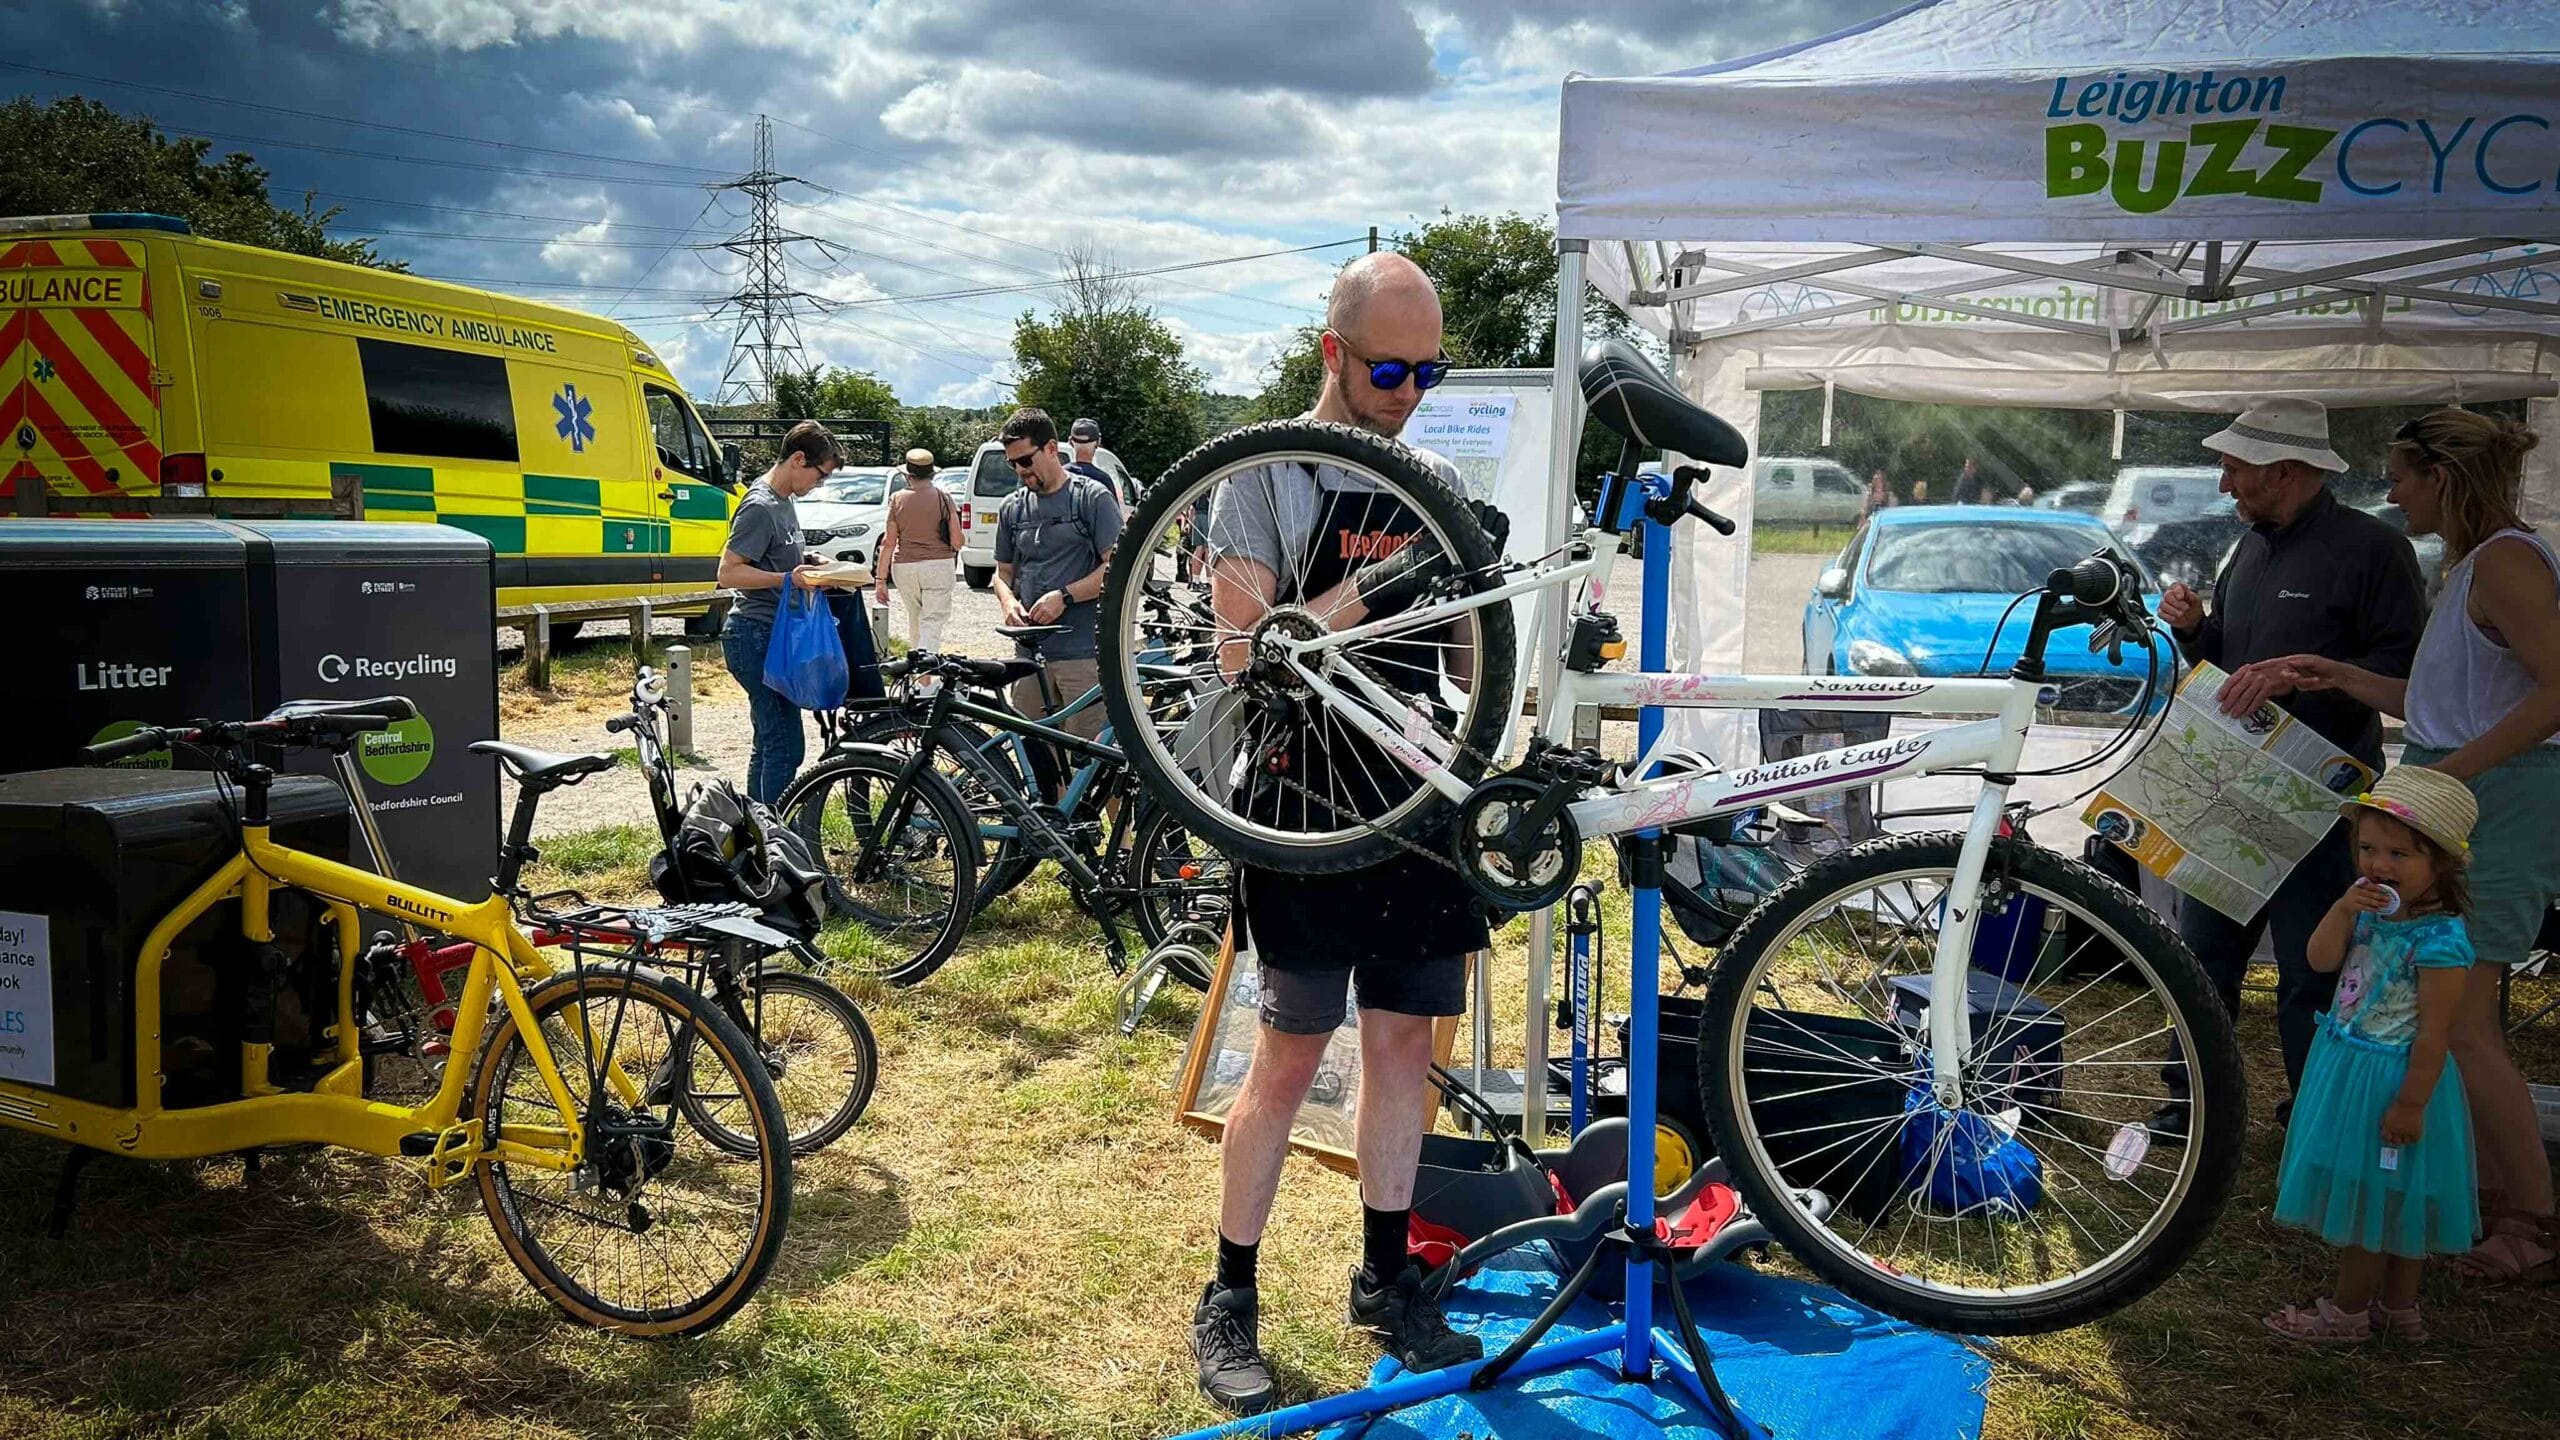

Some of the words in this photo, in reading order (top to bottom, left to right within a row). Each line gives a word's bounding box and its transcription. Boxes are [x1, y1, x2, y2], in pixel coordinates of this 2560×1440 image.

[2046, 71, 2287, 124] Leighton
[198, 306, 222, 318] 1006
[317, 296, 444, 336] EMERGENCY
[452, 319, 557, 353] AMBULANCE
[1468, 404, 1506, 417] cycling
[1424, 424, 1446, 434] Local
[1447, 424, 1465, 434] Bike
[1466, 424, 1491, 434] Rides
[356, 654, 457, 678] Recycling
[78, 662, 172, 690] Litter
[1809, 679, 1925, 692] Sorrento
[364, 731, 403, 745] Central
[365, 742, 430, 757] Bedfordshire
[1734, 755, 1831, 788] British
[1840, 738, 1926, 765] Eagle
[369, 797, 428, 813] Bedfordshire
[430, 792, 463, 805] Council
[0, 952, 35, 967] ance
